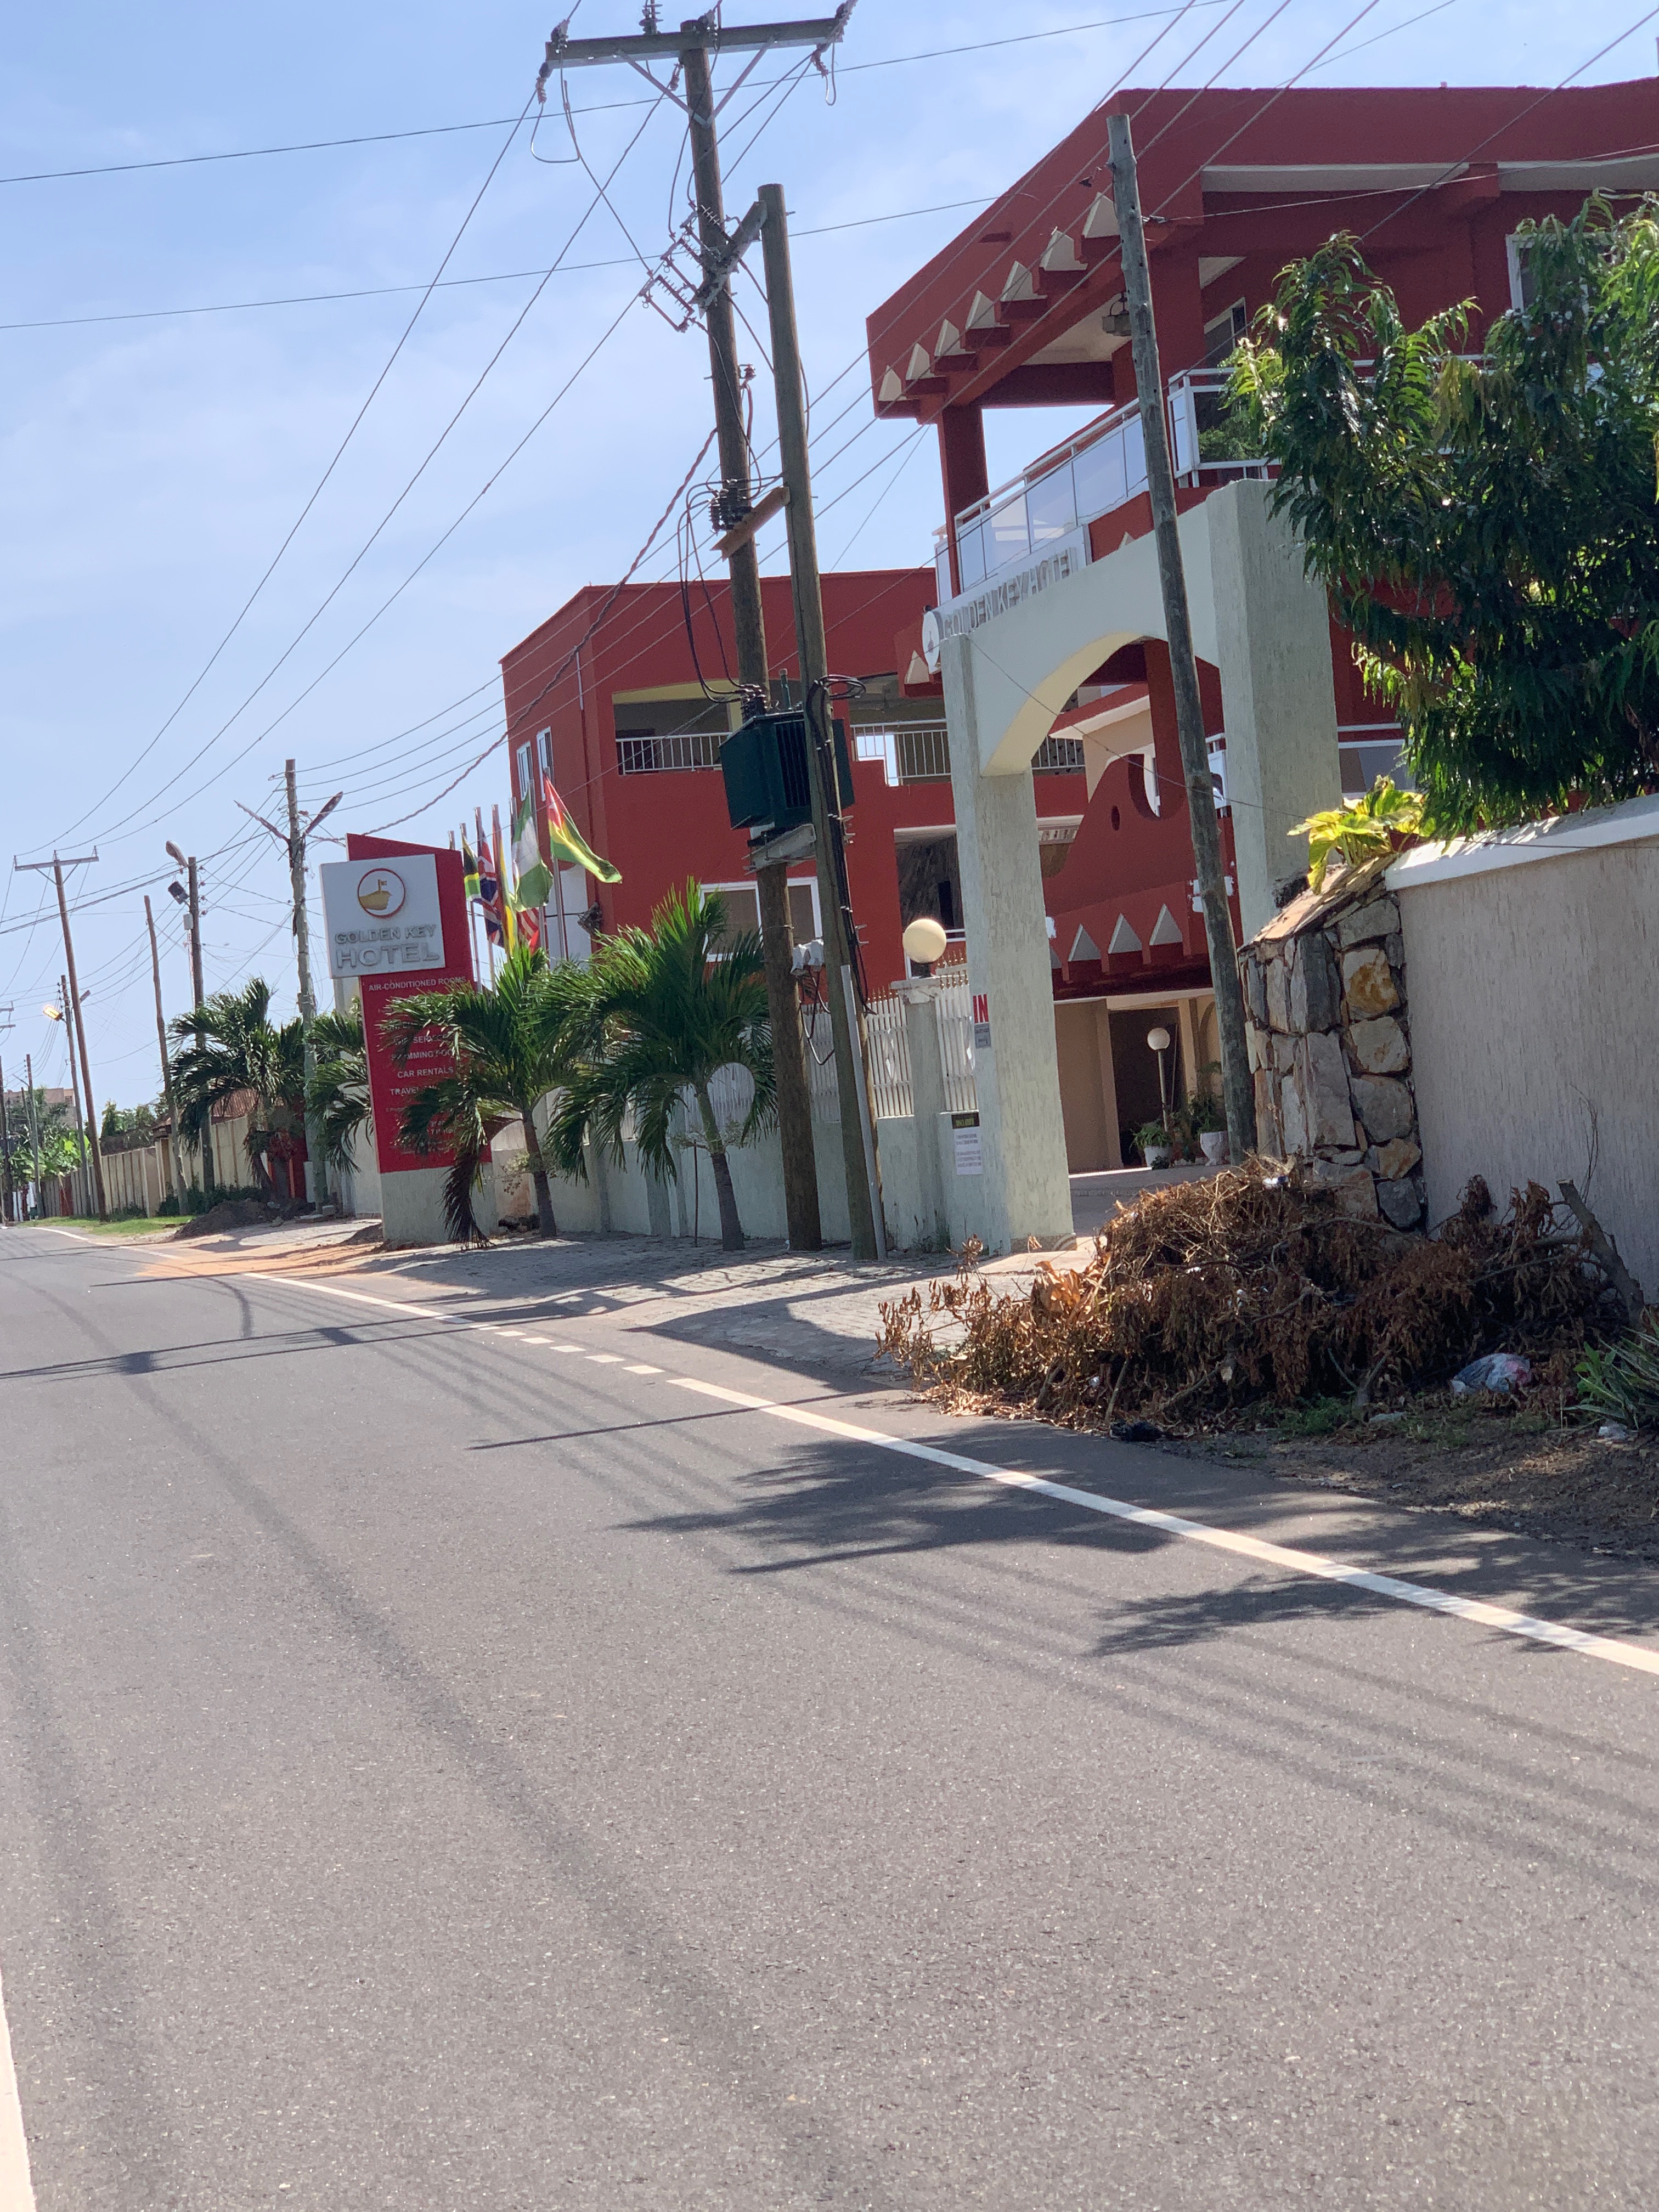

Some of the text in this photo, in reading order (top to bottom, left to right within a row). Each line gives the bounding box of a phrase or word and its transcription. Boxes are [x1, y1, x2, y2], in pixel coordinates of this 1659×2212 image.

[998, 574, 1029, 614] KEY
[335, 924, 437, 944] GOLDEN KEY
[336, 942, 439, 969] HOTEL
[368, 976, 466, 991] AIR-CONDITIONED ROOMS
[972, 994, 989, 1024] IN
[397, 1066, 454, 1079] CAR RENTALS
